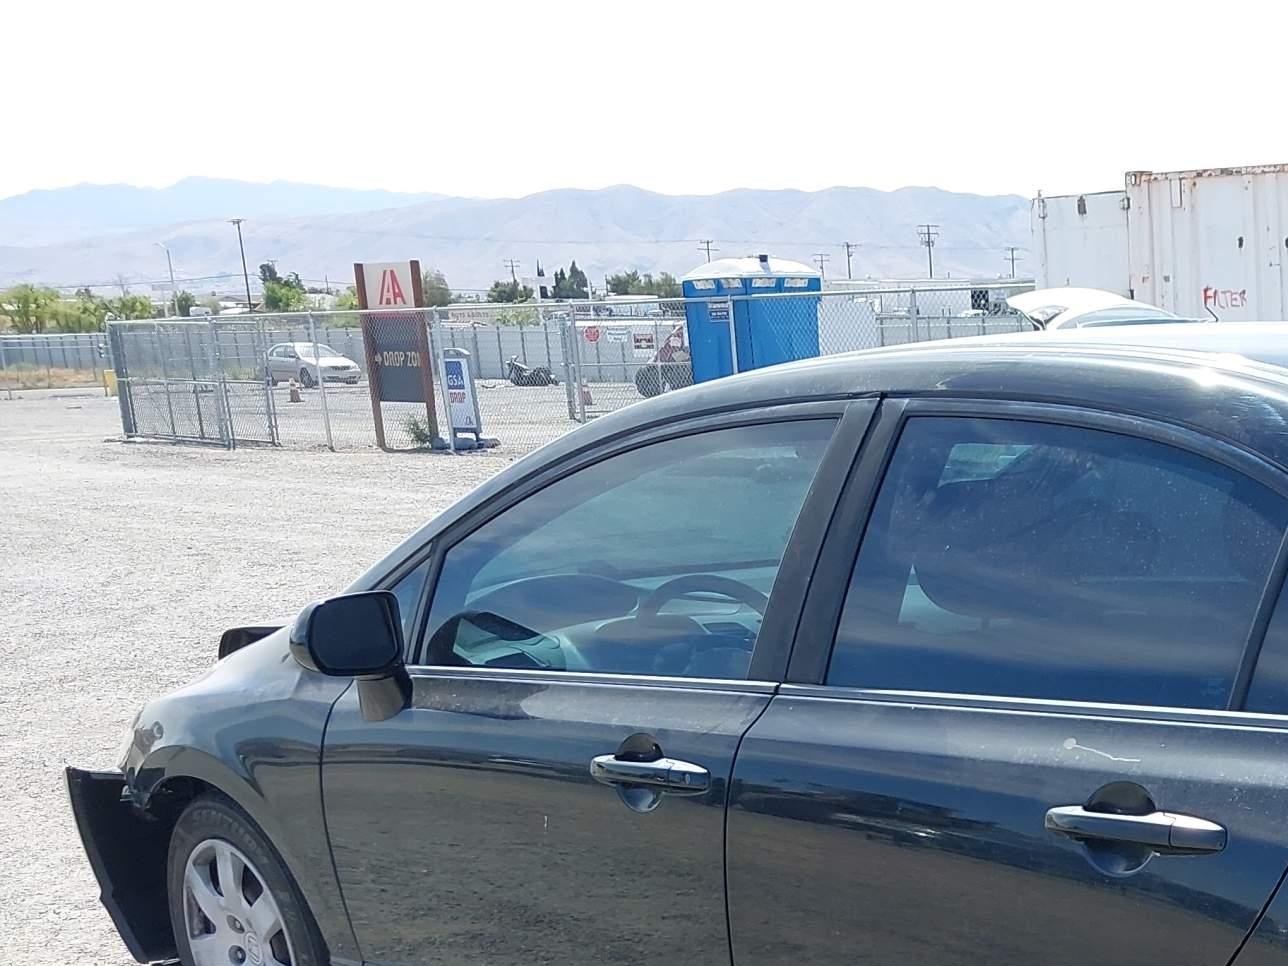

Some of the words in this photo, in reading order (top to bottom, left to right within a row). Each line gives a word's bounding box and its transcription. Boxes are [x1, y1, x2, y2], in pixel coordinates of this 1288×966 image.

[1203, 286, 1247, 309] FILTER
[383, 351, 405, 368] DROP
[448, 374, 464, 386] GSA
